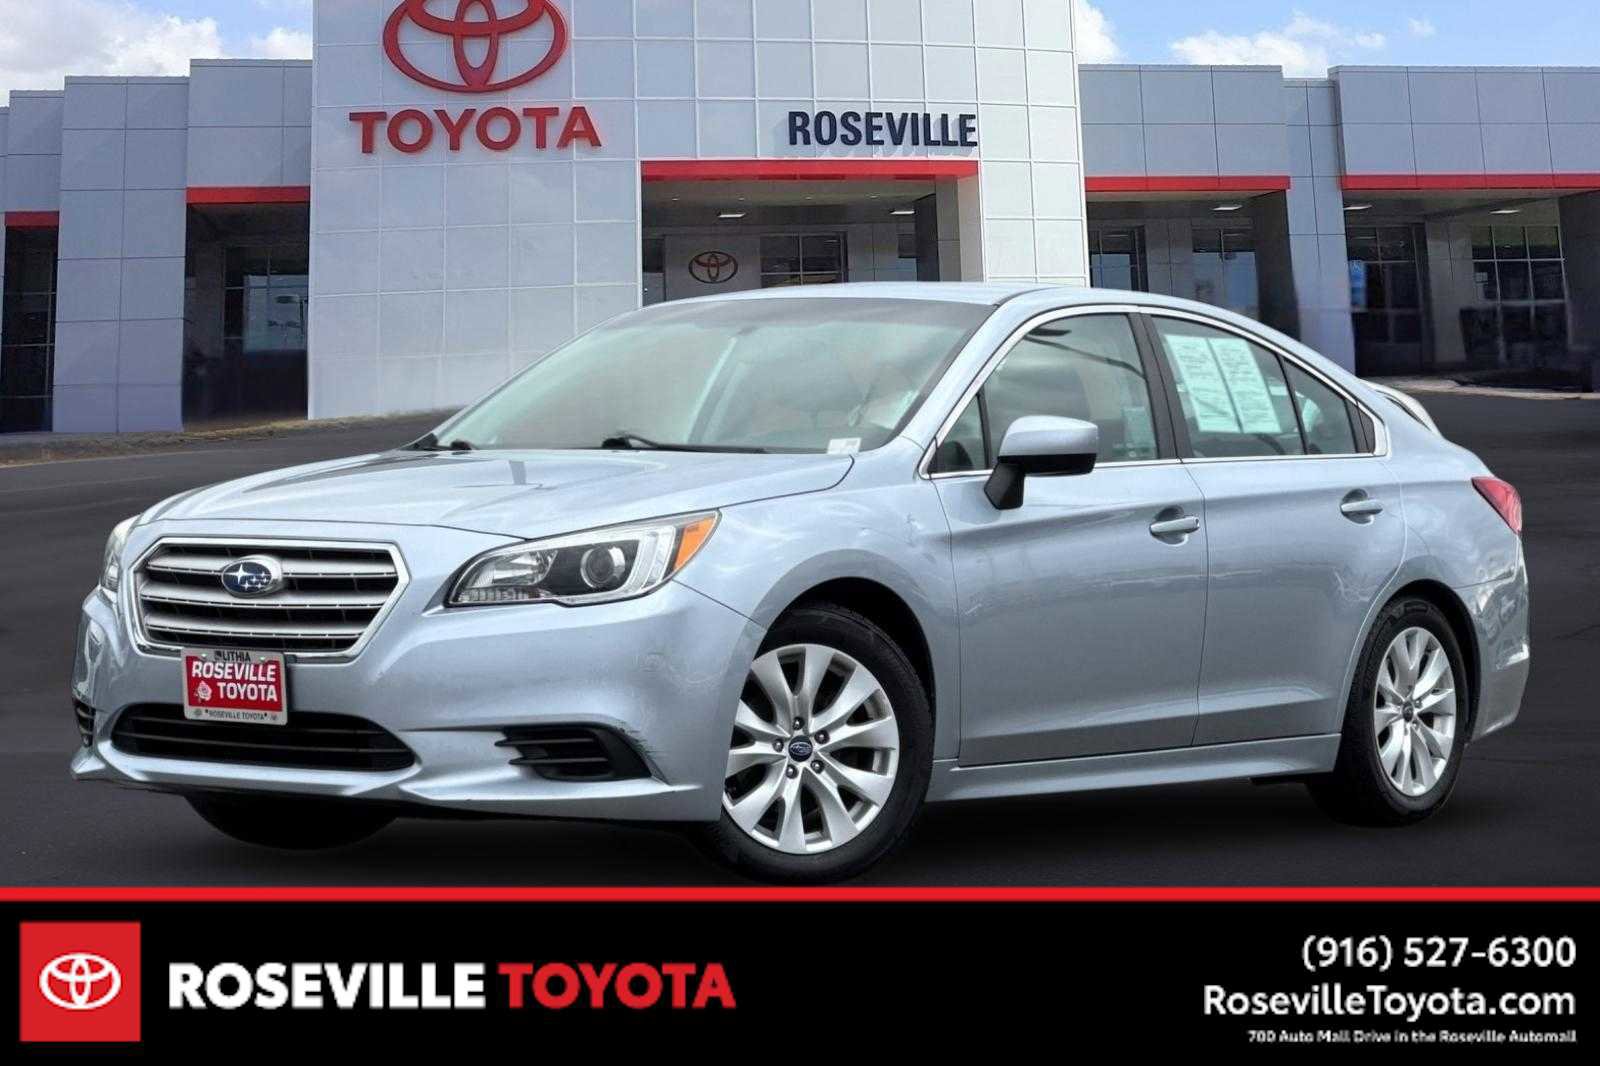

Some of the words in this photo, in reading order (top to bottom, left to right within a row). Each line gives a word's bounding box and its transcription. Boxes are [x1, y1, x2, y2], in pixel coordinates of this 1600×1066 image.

[349, 106, 602, 153] TOYOTA
[788, 110, 978, 147] ROSEVILLE
[191, 661, 277, 682] ROSEVILLE
[217, 682, 278, 702] TOYOTA
